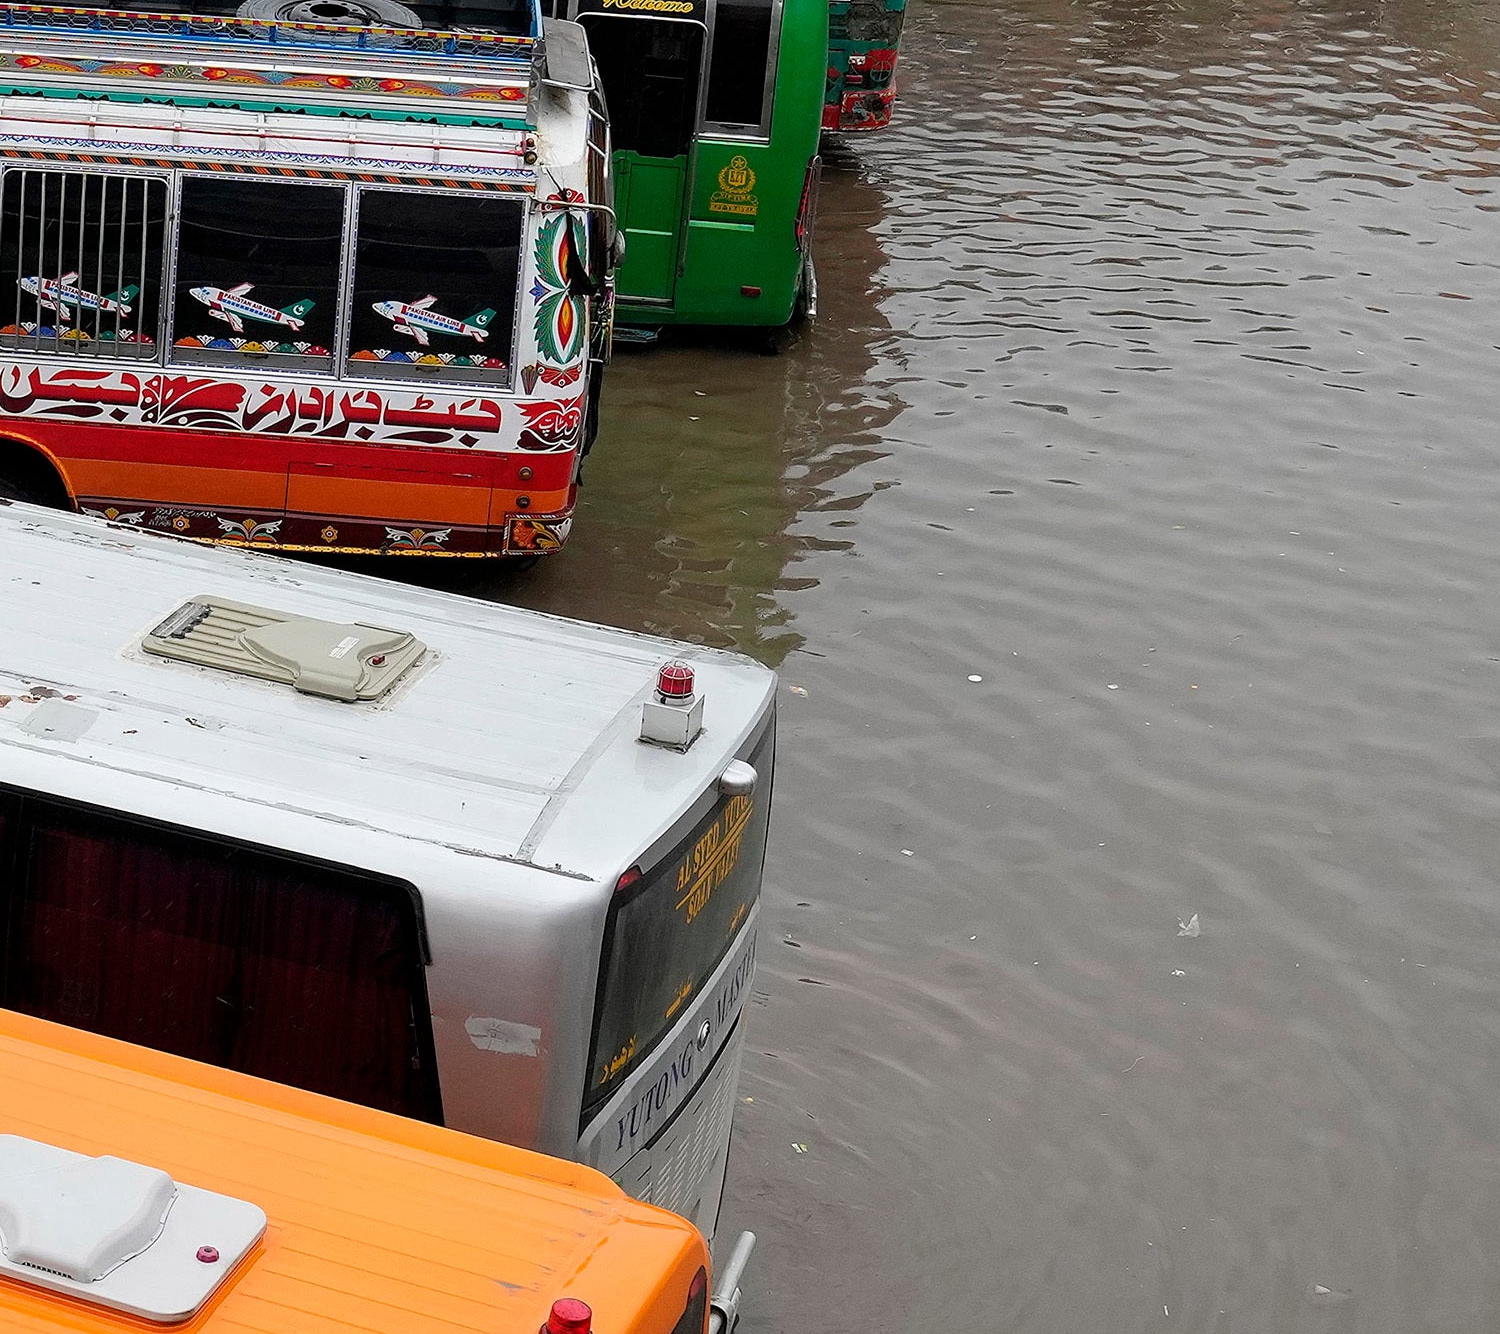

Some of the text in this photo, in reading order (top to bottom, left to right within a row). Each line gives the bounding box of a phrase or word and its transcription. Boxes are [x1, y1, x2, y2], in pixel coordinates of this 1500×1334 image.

[223, 291, 277, 316] PAKISTAN AIR LINE
[407, 304, 461, 328] PAKISTAN AIR LINE
[675, 846, 694, 892] AL
[615, 1039, 695, 1153] YUTONG
